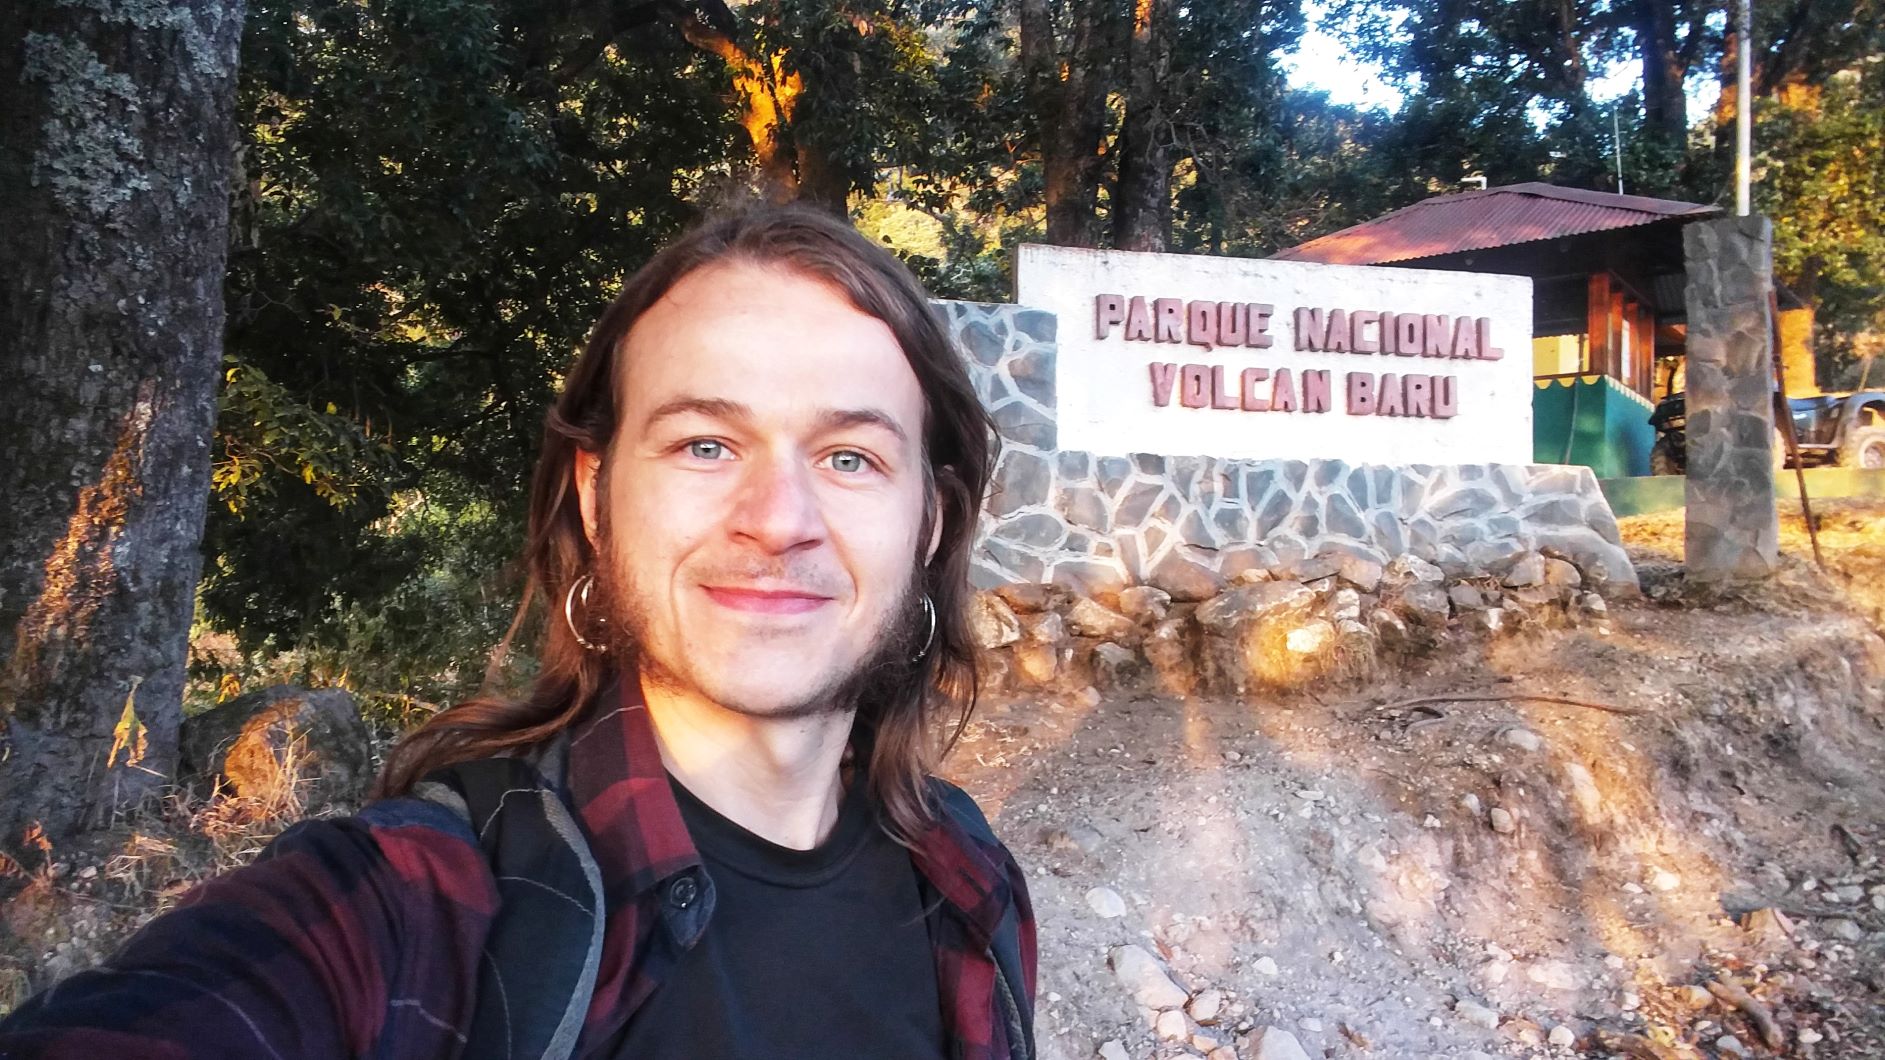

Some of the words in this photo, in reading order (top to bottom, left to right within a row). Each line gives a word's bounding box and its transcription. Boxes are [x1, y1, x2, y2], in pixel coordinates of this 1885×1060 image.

[1096, 294, 1274, 351] PARQUE
[1294, 307, 1504, 360] NACIONAL
[1150, 362, 1331, 413] VOLCAN
[1347, 372, 1458, 418] BARU
